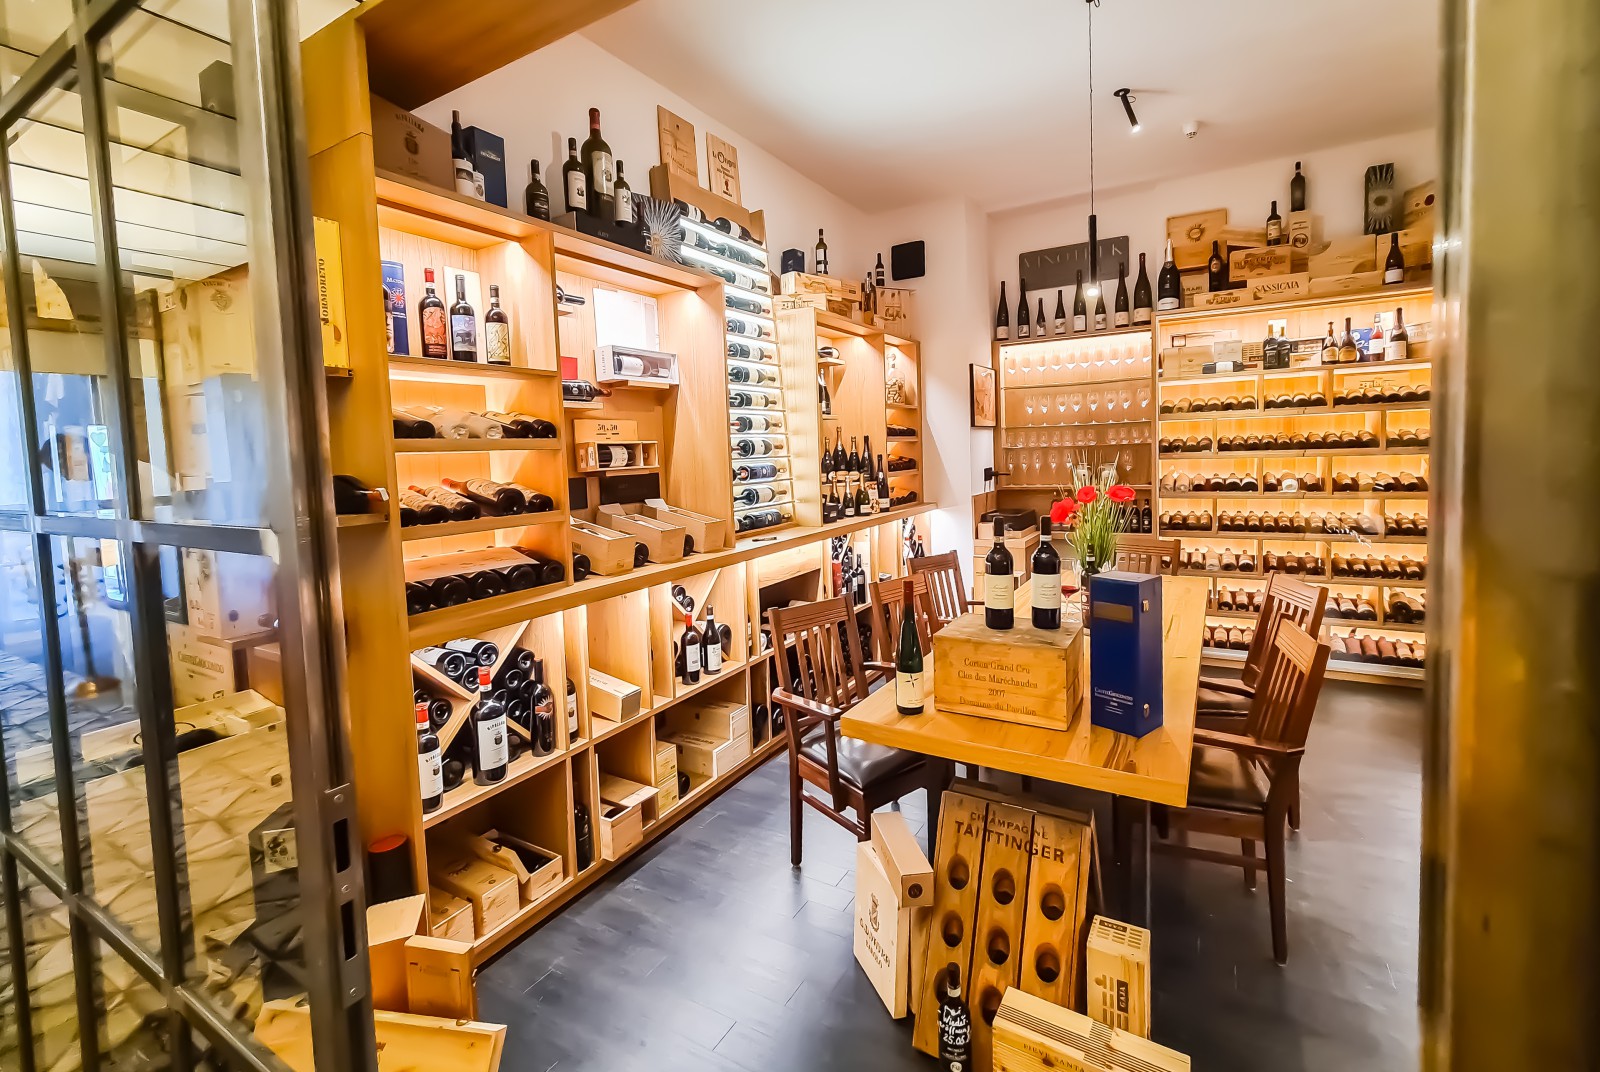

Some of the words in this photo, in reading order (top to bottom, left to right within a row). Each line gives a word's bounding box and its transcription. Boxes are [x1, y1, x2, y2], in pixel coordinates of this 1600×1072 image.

[318, 258, 330, 326] MORMORETO
[1255, 280, 1300, 293] SASSICAIA
[957, 669, 973, 680] Clos
[974, 673, 987, 682] des
[990, 660, 1014, 672] Grand
[1016, 663, 1030, 674] Cru
[988, 687, 1006, 698] 2007
[959, 696, 992, 710] Domaine
[994, 702, 1004, 711] du
[1006, 702, 1037, 717] Pavillon
[955, 820, 1065, 864] TAITTINGER
[1119, 986, 1127, 1008] GAJA
